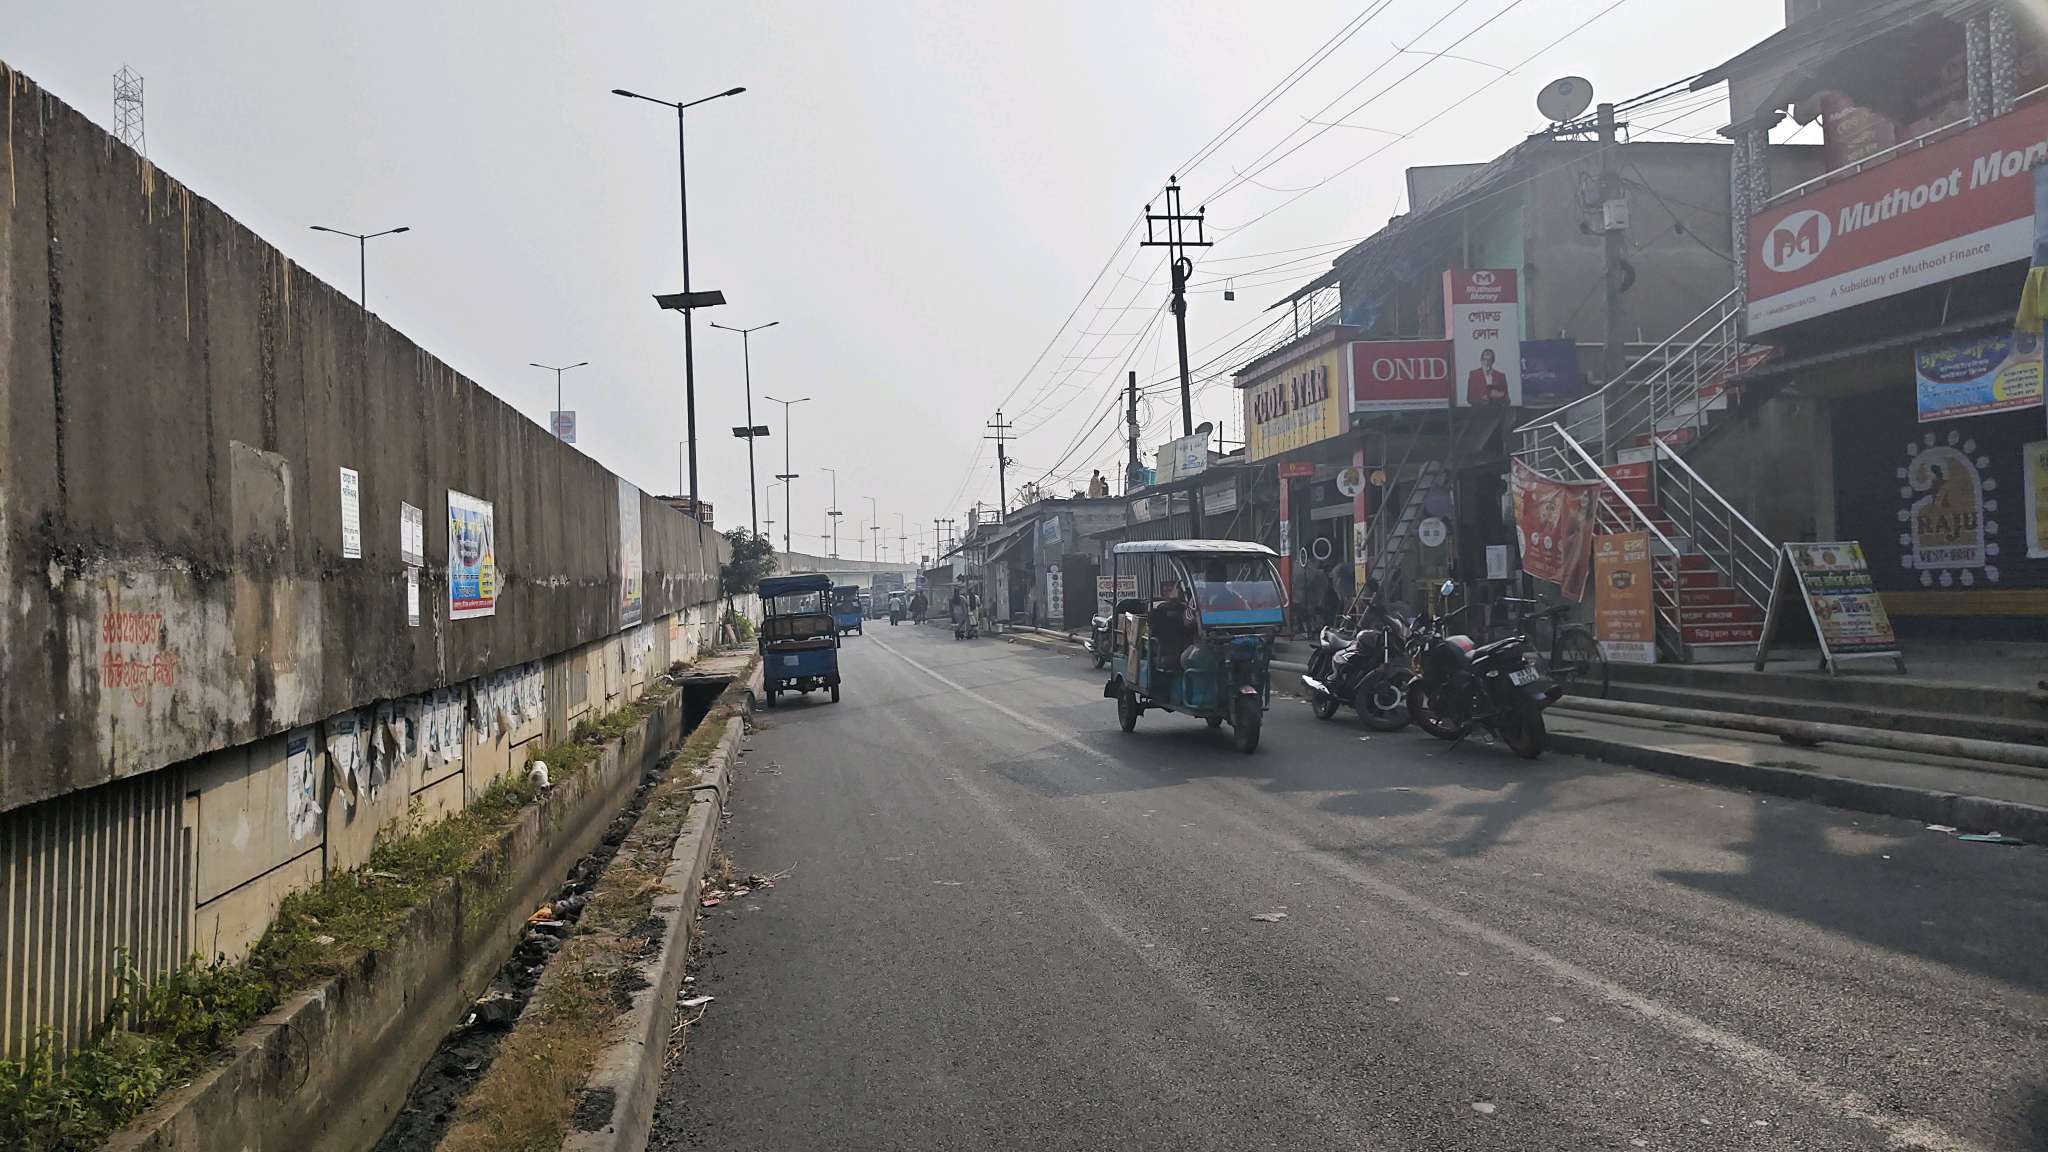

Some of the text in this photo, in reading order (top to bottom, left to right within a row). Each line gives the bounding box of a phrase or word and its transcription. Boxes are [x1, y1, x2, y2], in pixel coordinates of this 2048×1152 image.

[1838, 166, 1962, 236] Muthoot
[1830, 242, 1991, 298] A Subsidiary of Muthoot Finance
[1918, 512, 1978, 542] RAJU
